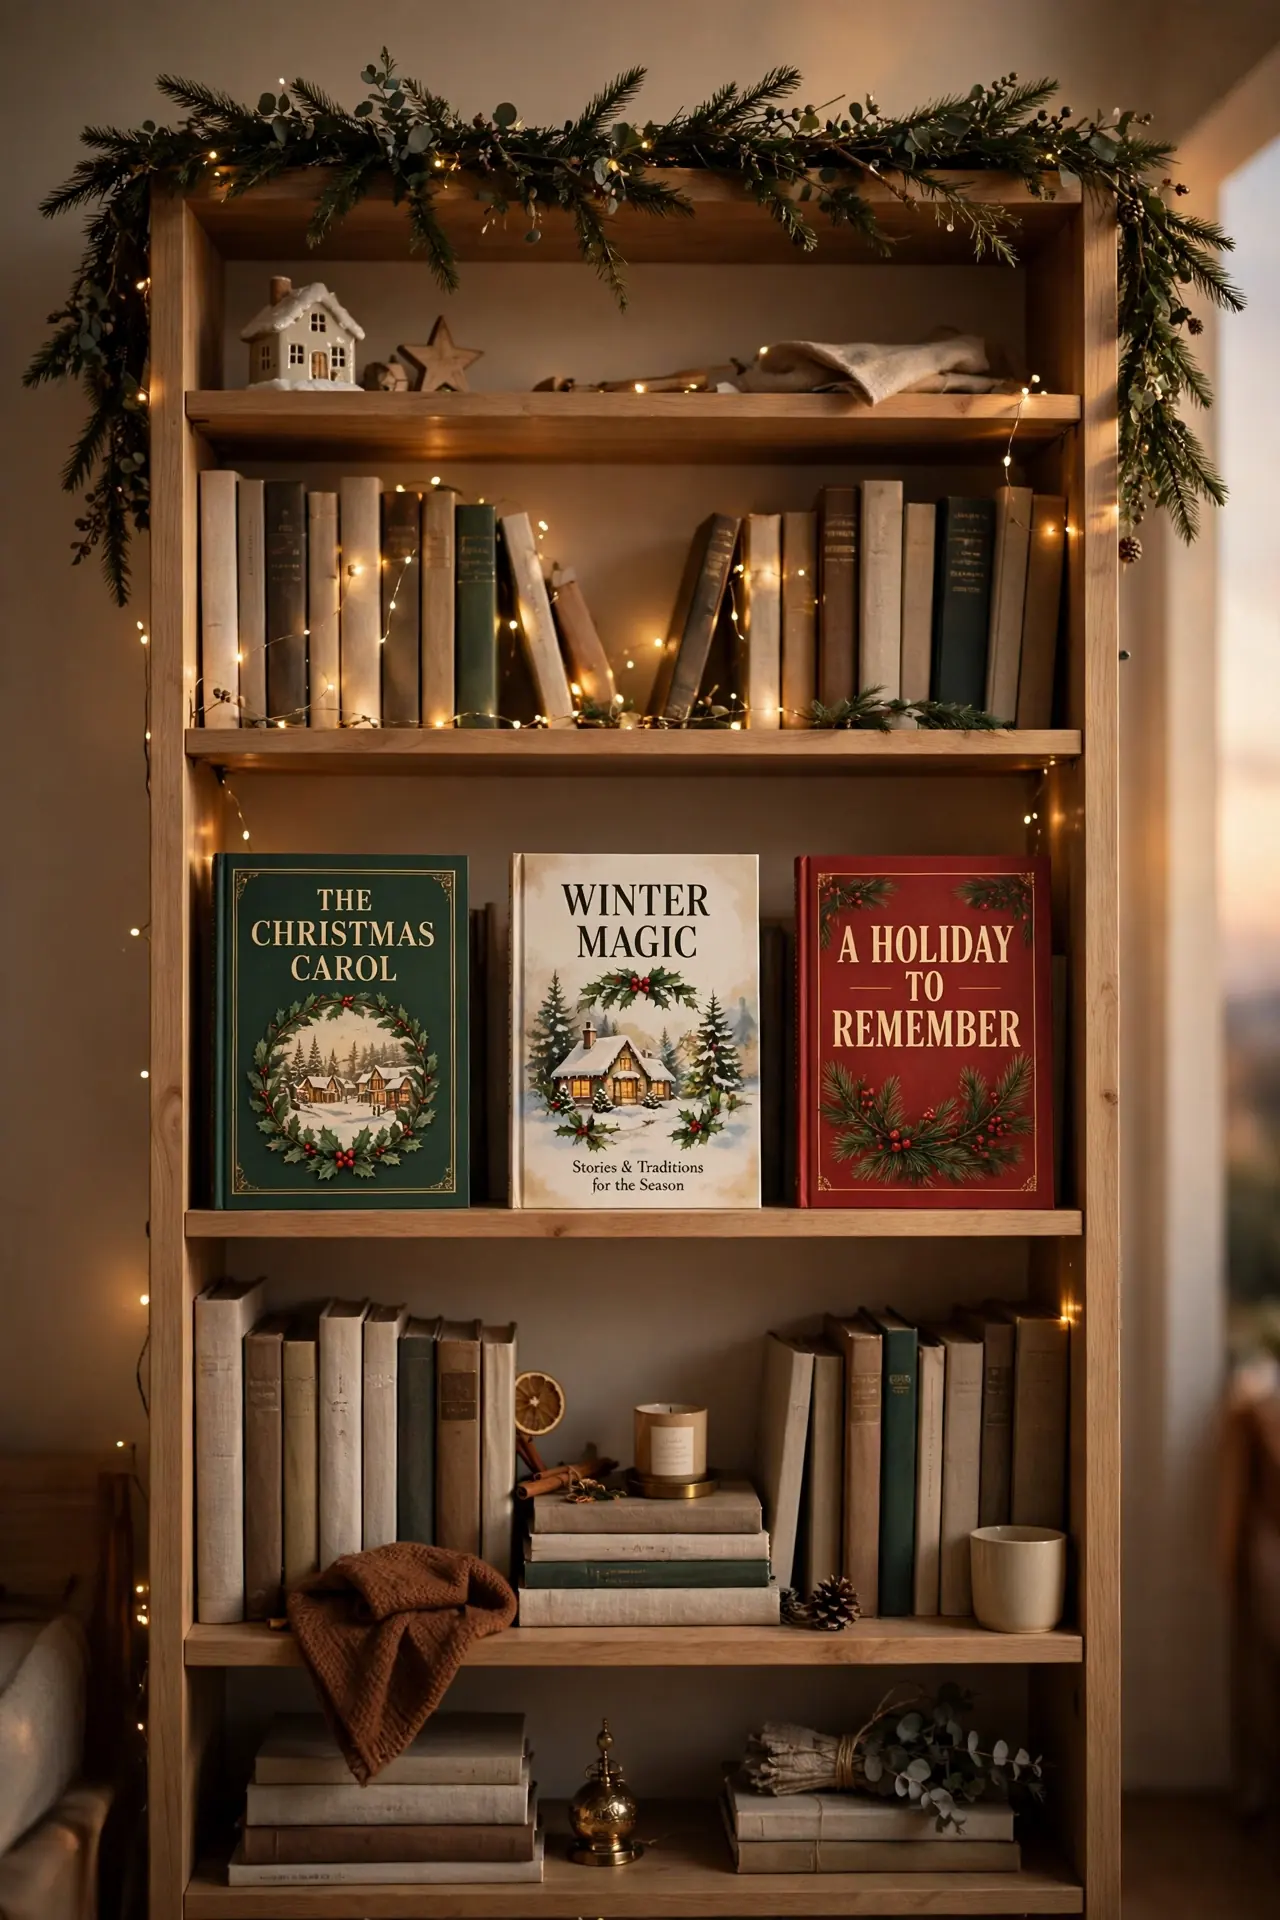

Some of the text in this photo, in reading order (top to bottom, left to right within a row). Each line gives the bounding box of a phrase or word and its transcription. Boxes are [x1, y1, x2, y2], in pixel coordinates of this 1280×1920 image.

[317, 889, 372, 911] THE
[561, 883, 710, 917] WINTER
[251, 920, 435, 947] CHRISTMAS
[577, 925, 698, 959] MAGIC
[837, 925, 1014, 964] A HOLIDAY
[291, 955, 397, 981] CAROL
[905, 970, 944, 1002] TO
[832, 1010, 1021, 1048] REMEMBER
[572, 1160, 704, 1174] Stories & Traditions
[592, 1177, 685, 1195] for the Season
